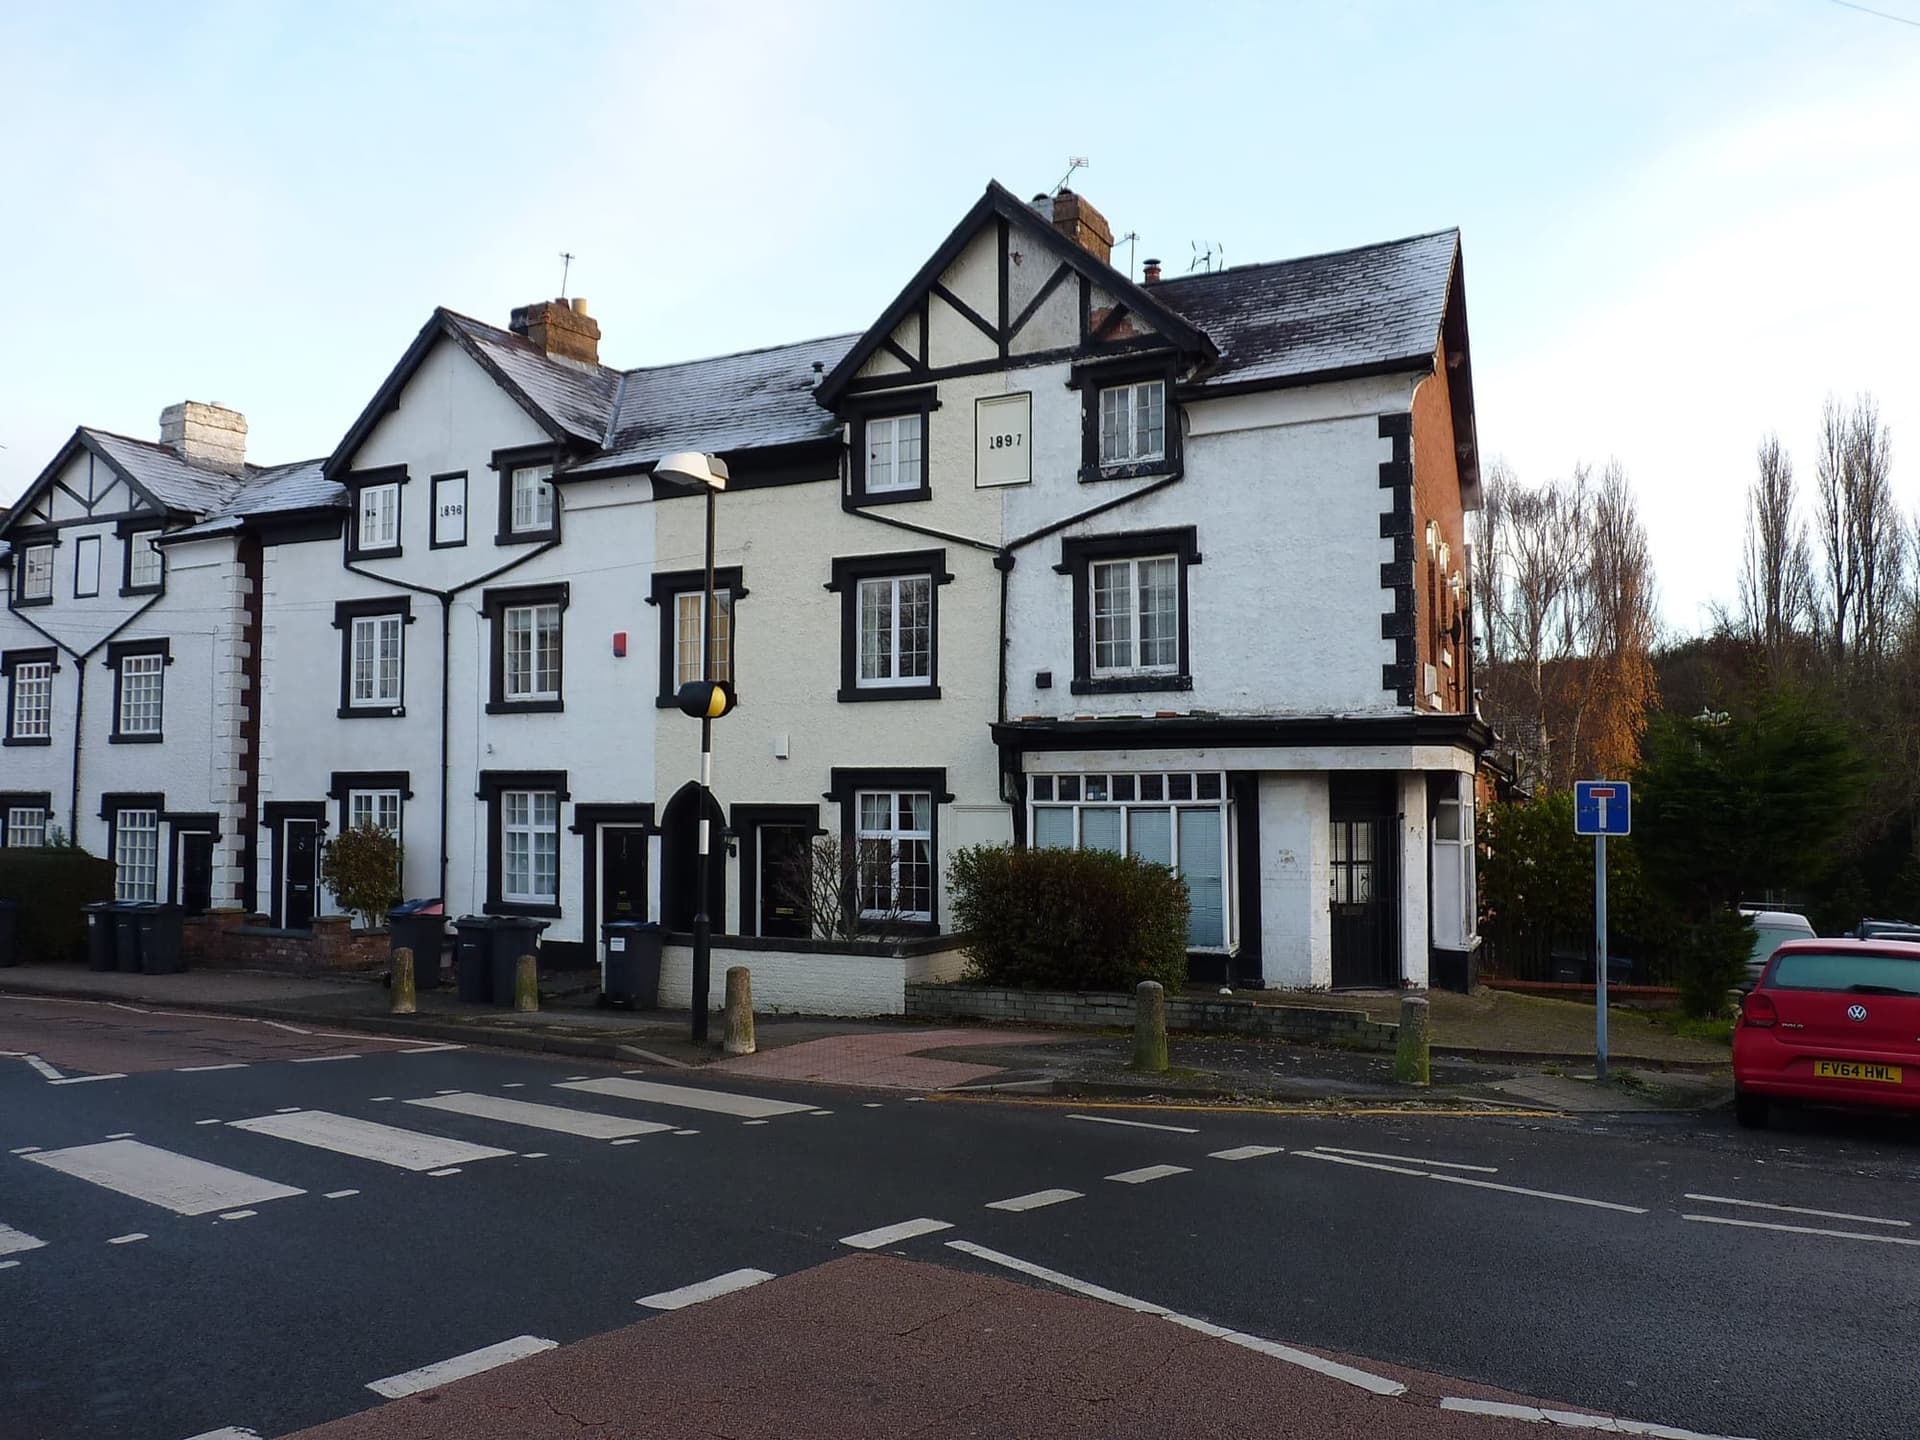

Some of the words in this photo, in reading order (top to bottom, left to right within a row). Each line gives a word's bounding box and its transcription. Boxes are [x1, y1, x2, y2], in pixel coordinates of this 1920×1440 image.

[989, 433, 1022, 449] 1897
[1820, 1062, 1861, 1077] FV64
[1864, 1065, 1895, 1081] HWL
